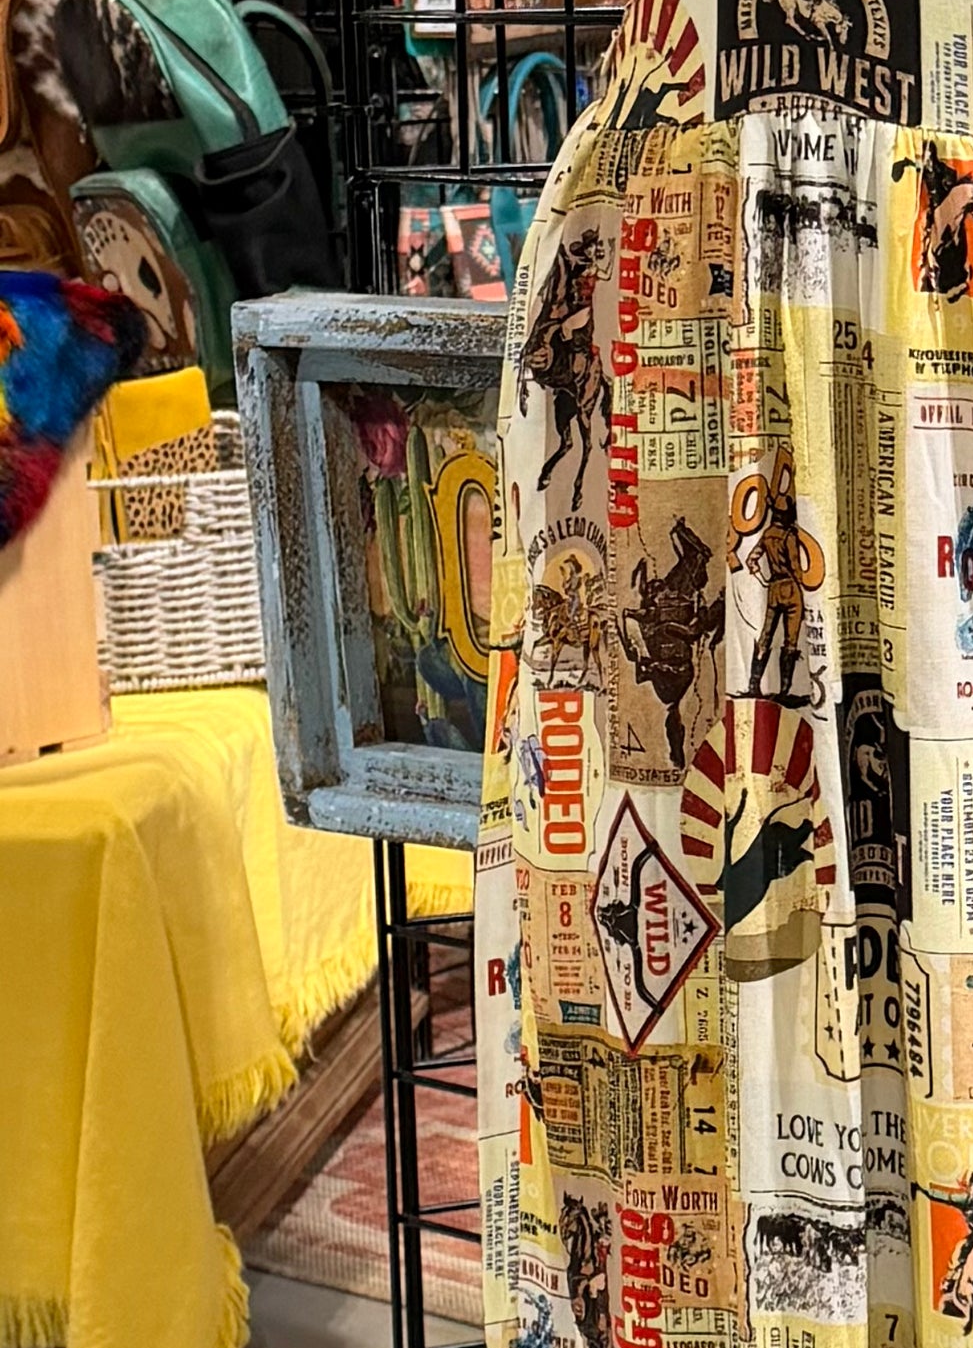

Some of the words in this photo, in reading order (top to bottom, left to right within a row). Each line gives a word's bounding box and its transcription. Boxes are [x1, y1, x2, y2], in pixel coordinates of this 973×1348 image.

[953, 34, 968, 69] YOUR
[719, 44, 800, 102] WILD
[816, 47, 916, 126] WEST
[954, 73, 969, 117] PLACE
[877, 411, 896, 517] AMERICAN
[880, 532, 897, 611] LEAGUE
[538, 690, 588, 856] RODEO
[941, 789, 954, 823] YOUR
[941, 828, 955, 869] PLACE
[551, 884, 577, 896] FEB
[942, 873, 955, 906] HERE
[559, 902, 572, 928] 8
[645, 879, 671, 977] WILD
[905, 980, 924, 1078] 7796484
[693, 1105, 717, 1136] 14
[694, 1104, 718, 1136] 14
[776, 1113, 824, 1147] LOVE
[871, 1110, 907, 1144] THE
[781, 1152, 836, 1187] COWS
[493, 1176, 504, 1206] YOUR
[625, 1180, 656, 1210] FORT
[662, 1184, 719, 1213] WORTH
[885, 1315, 899, 1342] 7
